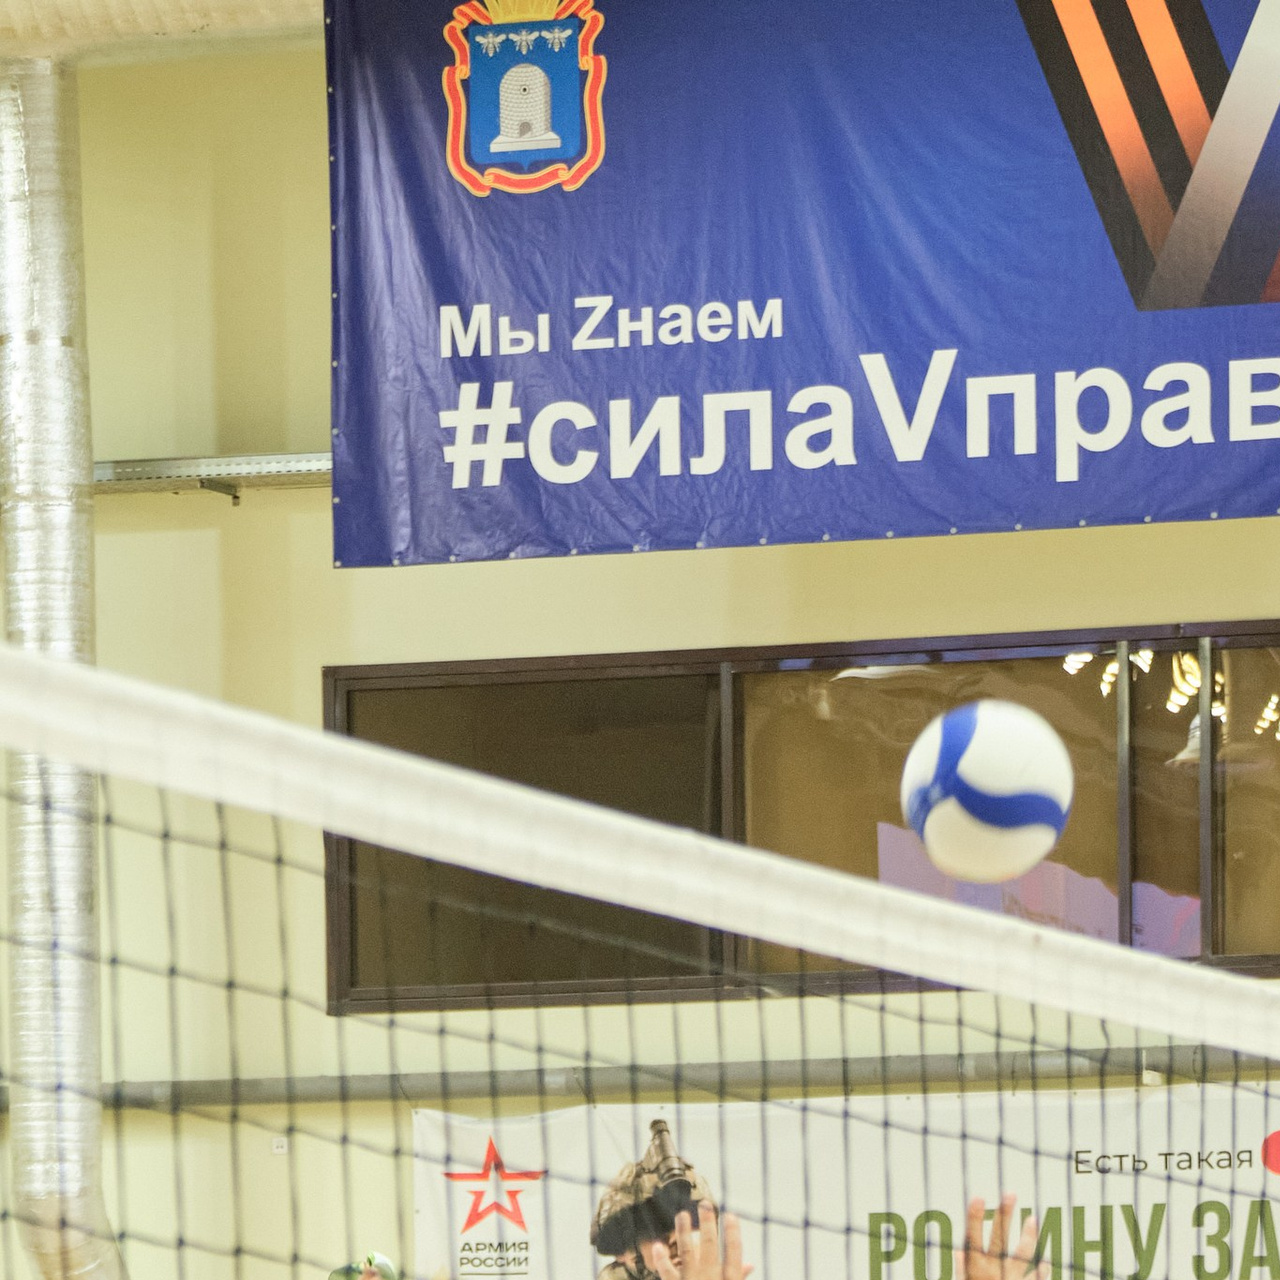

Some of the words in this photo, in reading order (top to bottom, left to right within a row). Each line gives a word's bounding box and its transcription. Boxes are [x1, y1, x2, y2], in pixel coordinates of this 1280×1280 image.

[438, 303, 550, 358] Мы
[571, 295, 783, 351] Zнаем
[1074, 1149, 1148, 1175] Есть
[1162, 1148, 1254, 1172] такая
[460, 1241, 529, 1254] АРМИЯ
[459, 1256, 529, 1268] РОССИИ
